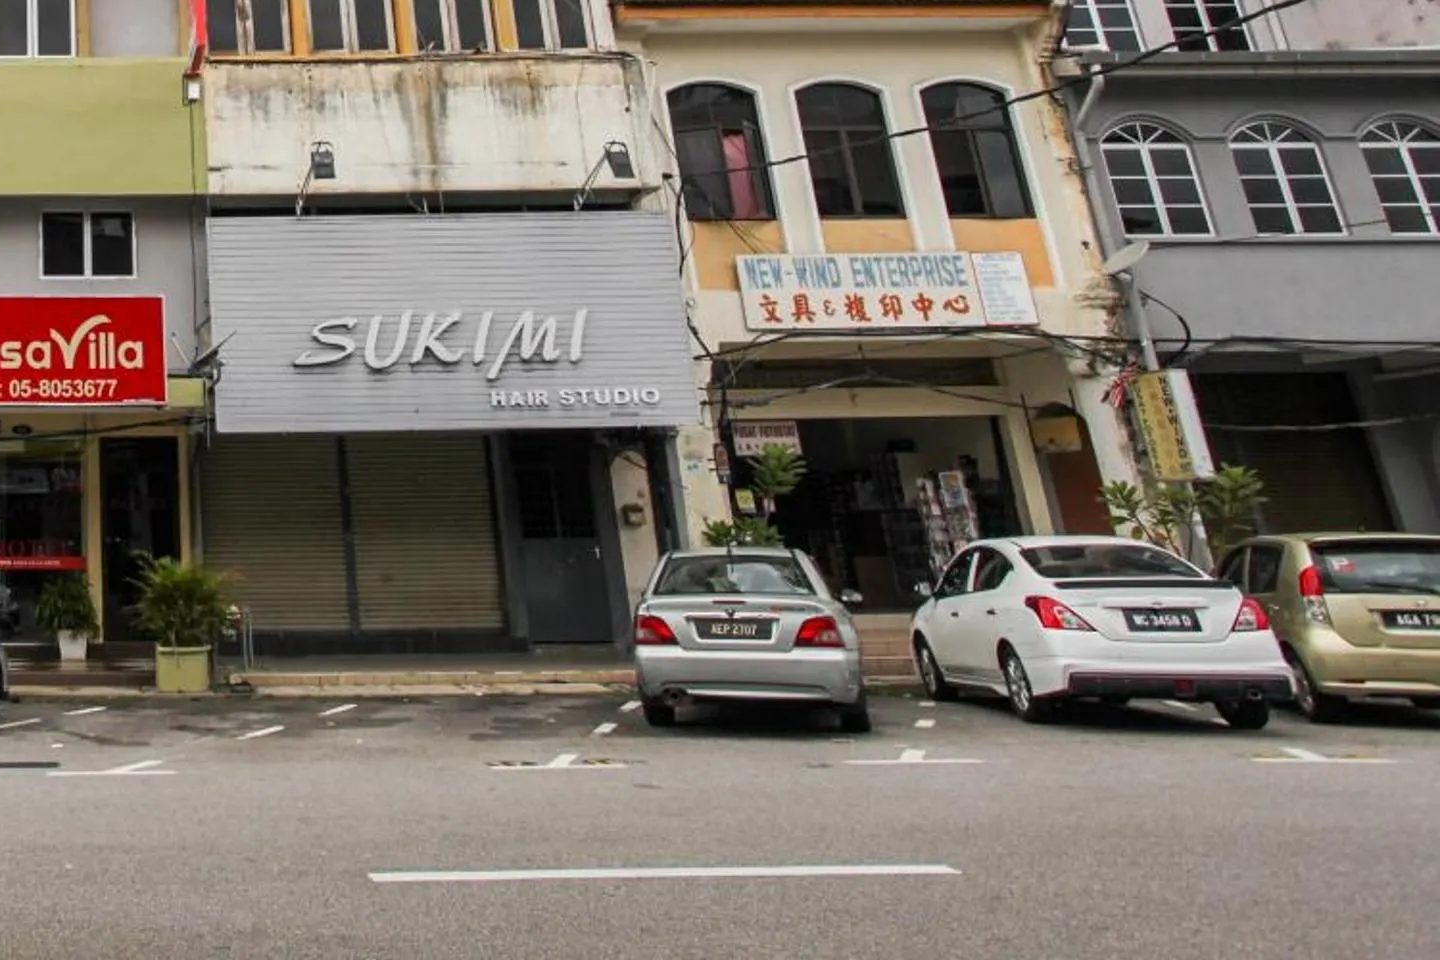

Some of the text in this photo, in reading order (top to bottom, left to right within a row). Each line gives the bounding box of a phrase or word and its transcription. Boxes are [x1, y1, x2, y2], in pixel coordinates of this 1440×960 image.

[744, 255, 842, 289] NEW-WIND
[849, 254, 970, 289] ENTERPRISE
[293, 308, 588, 382] SUKIMI
[8, 378, 119, 399] 05-8053677
[490, 387, 661, 408] HAIR STUDIO
